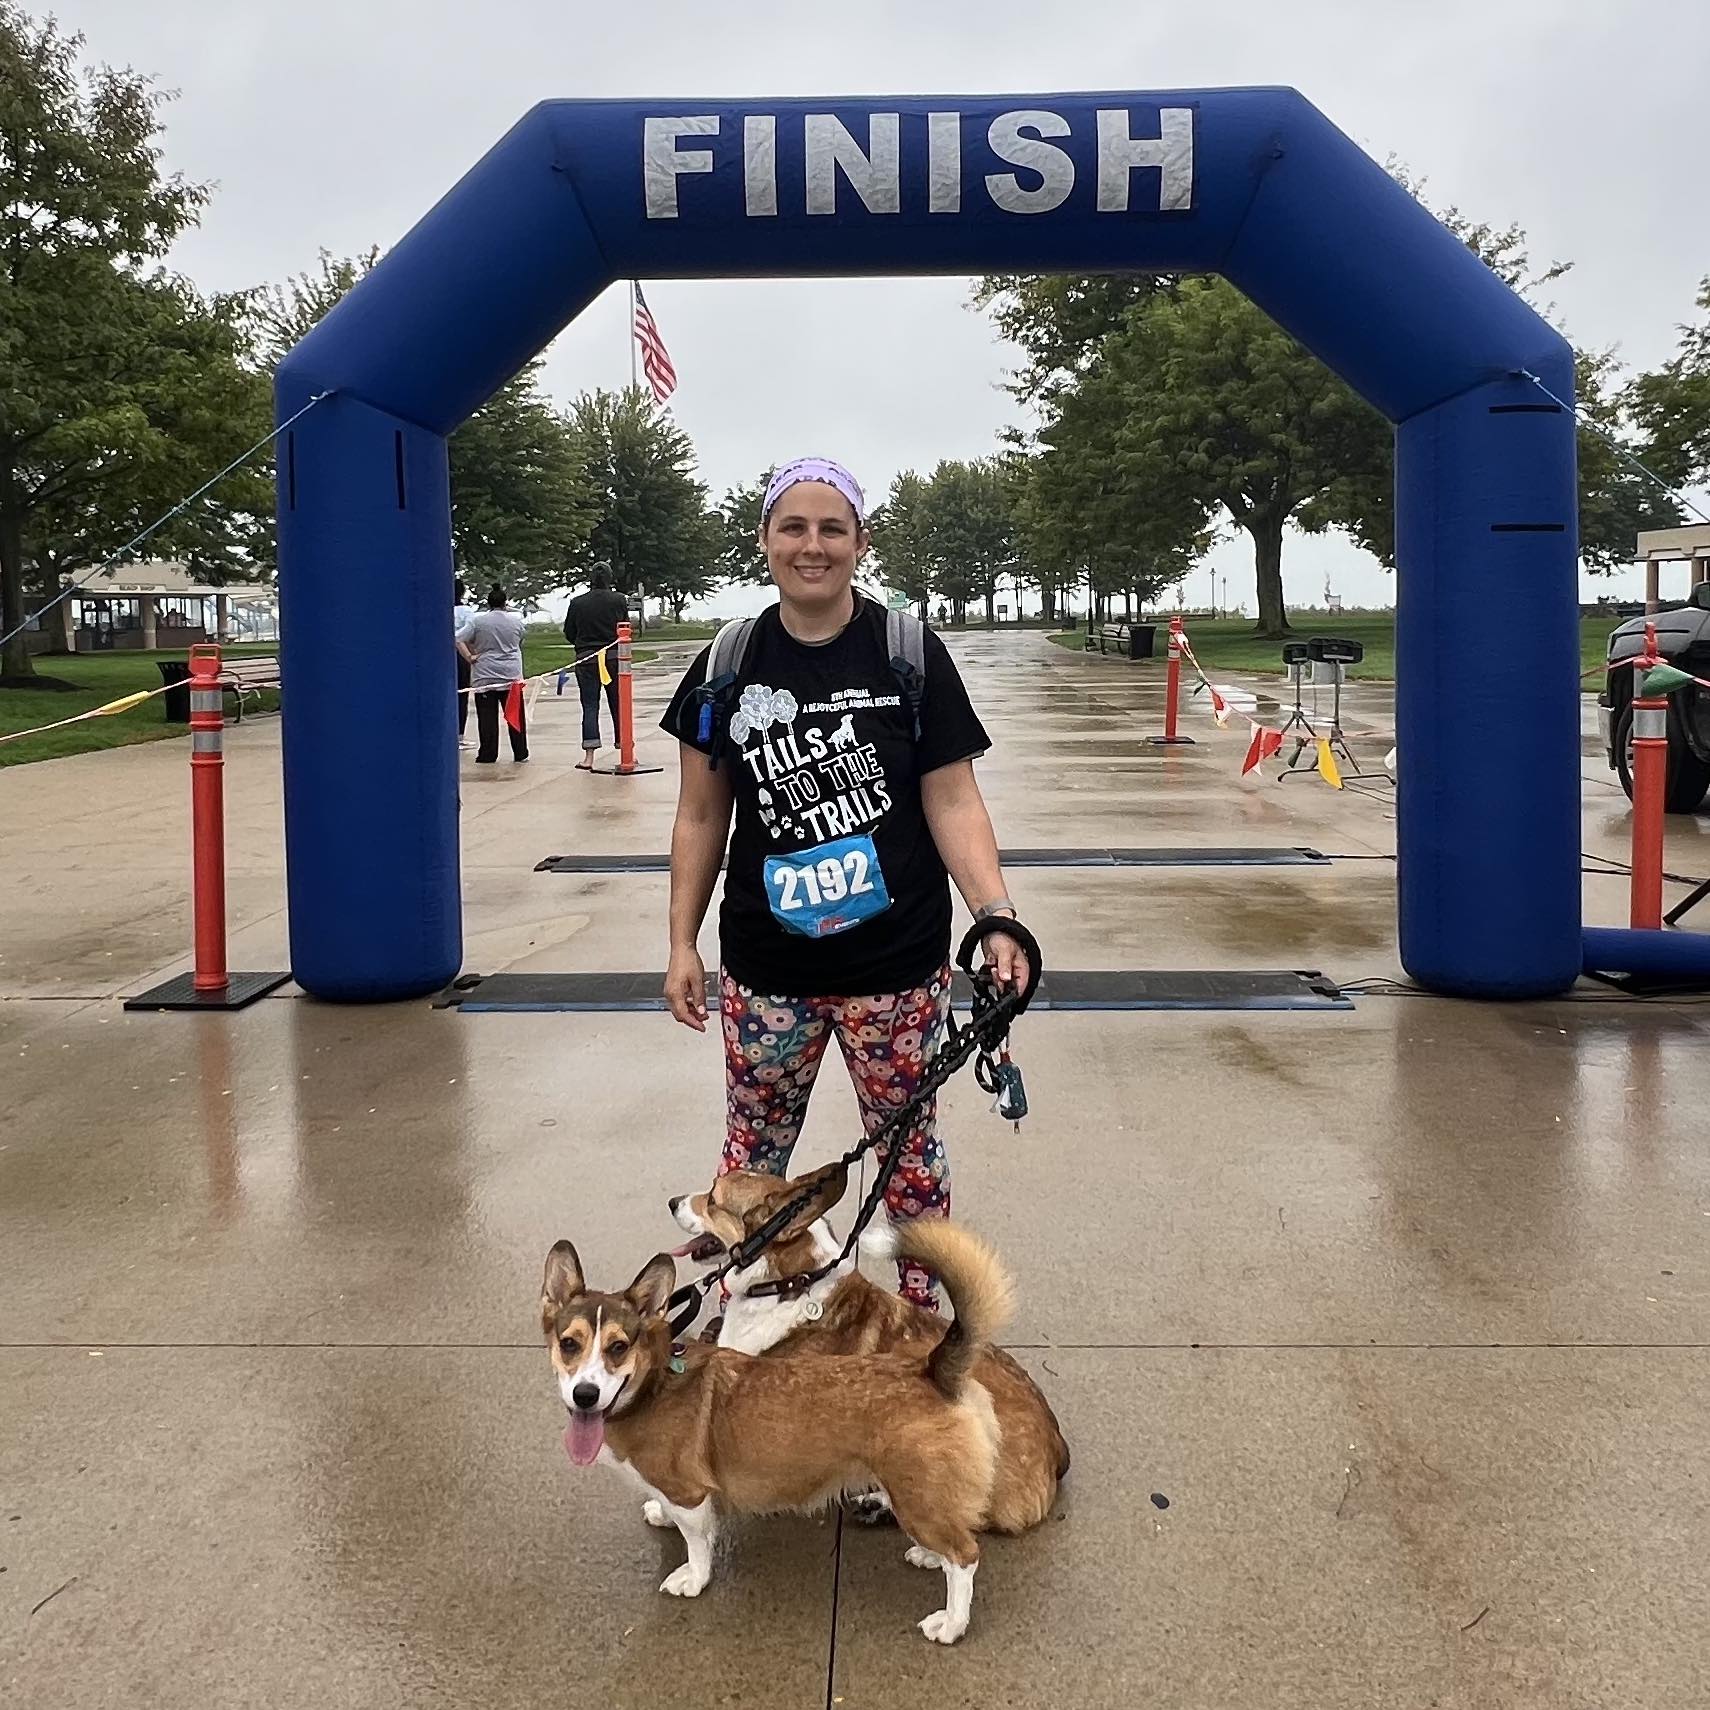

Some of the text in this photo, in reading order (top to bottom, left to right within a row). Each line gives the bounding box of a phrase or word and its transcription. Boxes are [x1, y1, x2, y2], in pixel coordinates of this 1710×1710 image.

[644, 108, 1193, 218] FINISH
[802, 703, 808, 713] A
[849, 698, 874, 708] ANIMAL
[875, 695, 900, 707] RESCUE
[743, 727, 828, 783] TAILS
[774, 743, 884, 810] TO THE
[800, 780, 892, 842] TRAILS
[774, 850, 874, 911] 2192
